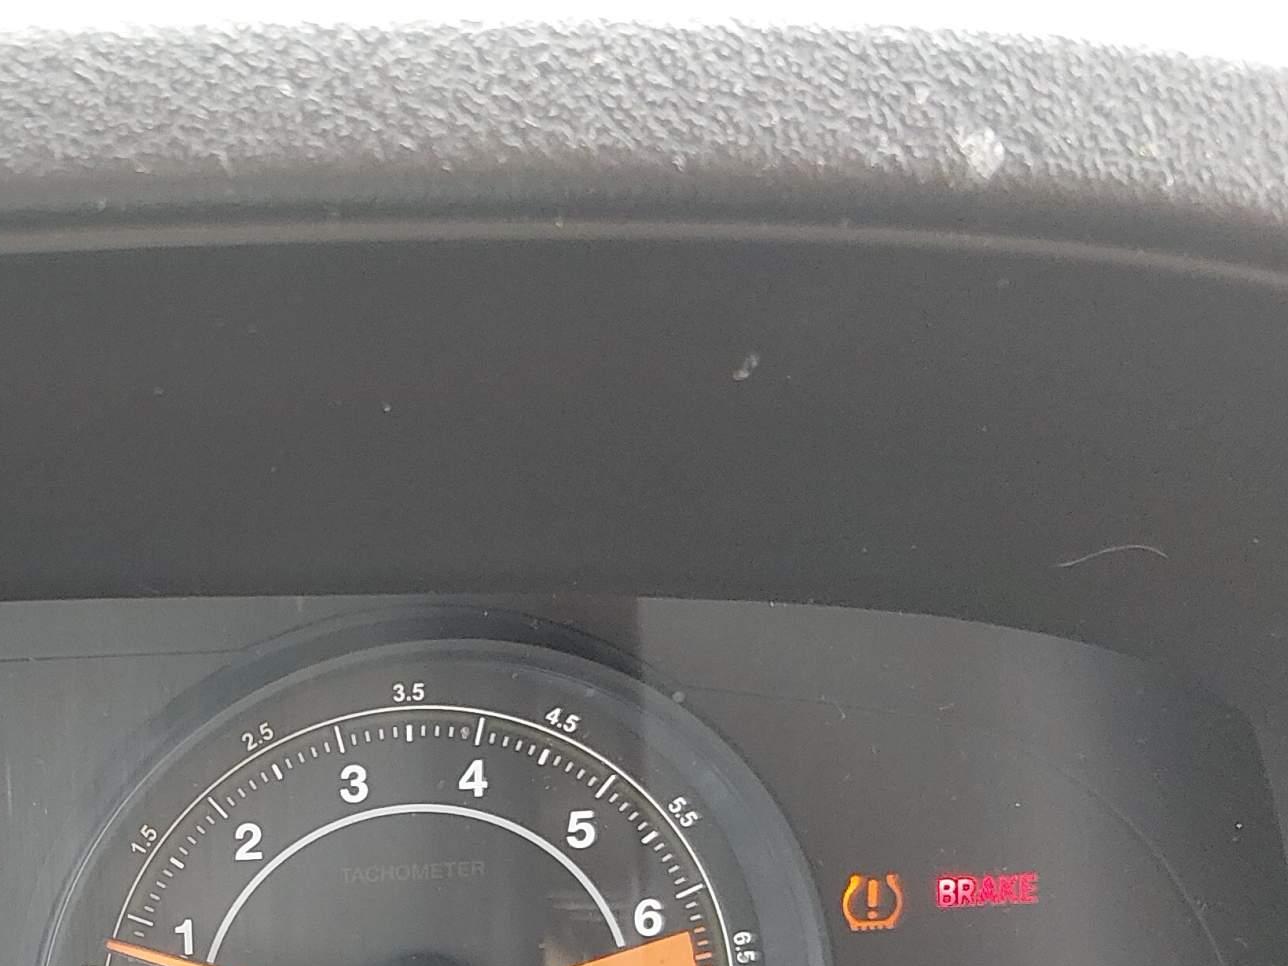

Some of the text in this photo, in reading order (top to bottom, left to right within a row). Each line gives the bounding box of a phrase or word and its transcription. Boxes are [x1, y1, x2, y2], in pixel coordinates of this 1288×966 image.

[392, 682, 425, 703] 3.5
[241, 722, 274, 751] 2.5
[545, 707, 581, 733] 4.5
[339, 764, 369, 803] 3
[458, 759, 489, 798] 4
[668, 796, 699, 827] 5.5
[130, 824, 157, 854] 1.5
[234, 822, 263, 861] 2
[566, 810, 596, 849] 5
[341, 861, 486, 884] TACHOMETER
[937, 872, 1038, 907] BRAKE
[633, 898, 665, 937] 6
[174, 919, 194, 956] 1
[733, 931, 756, 964] 6.5
